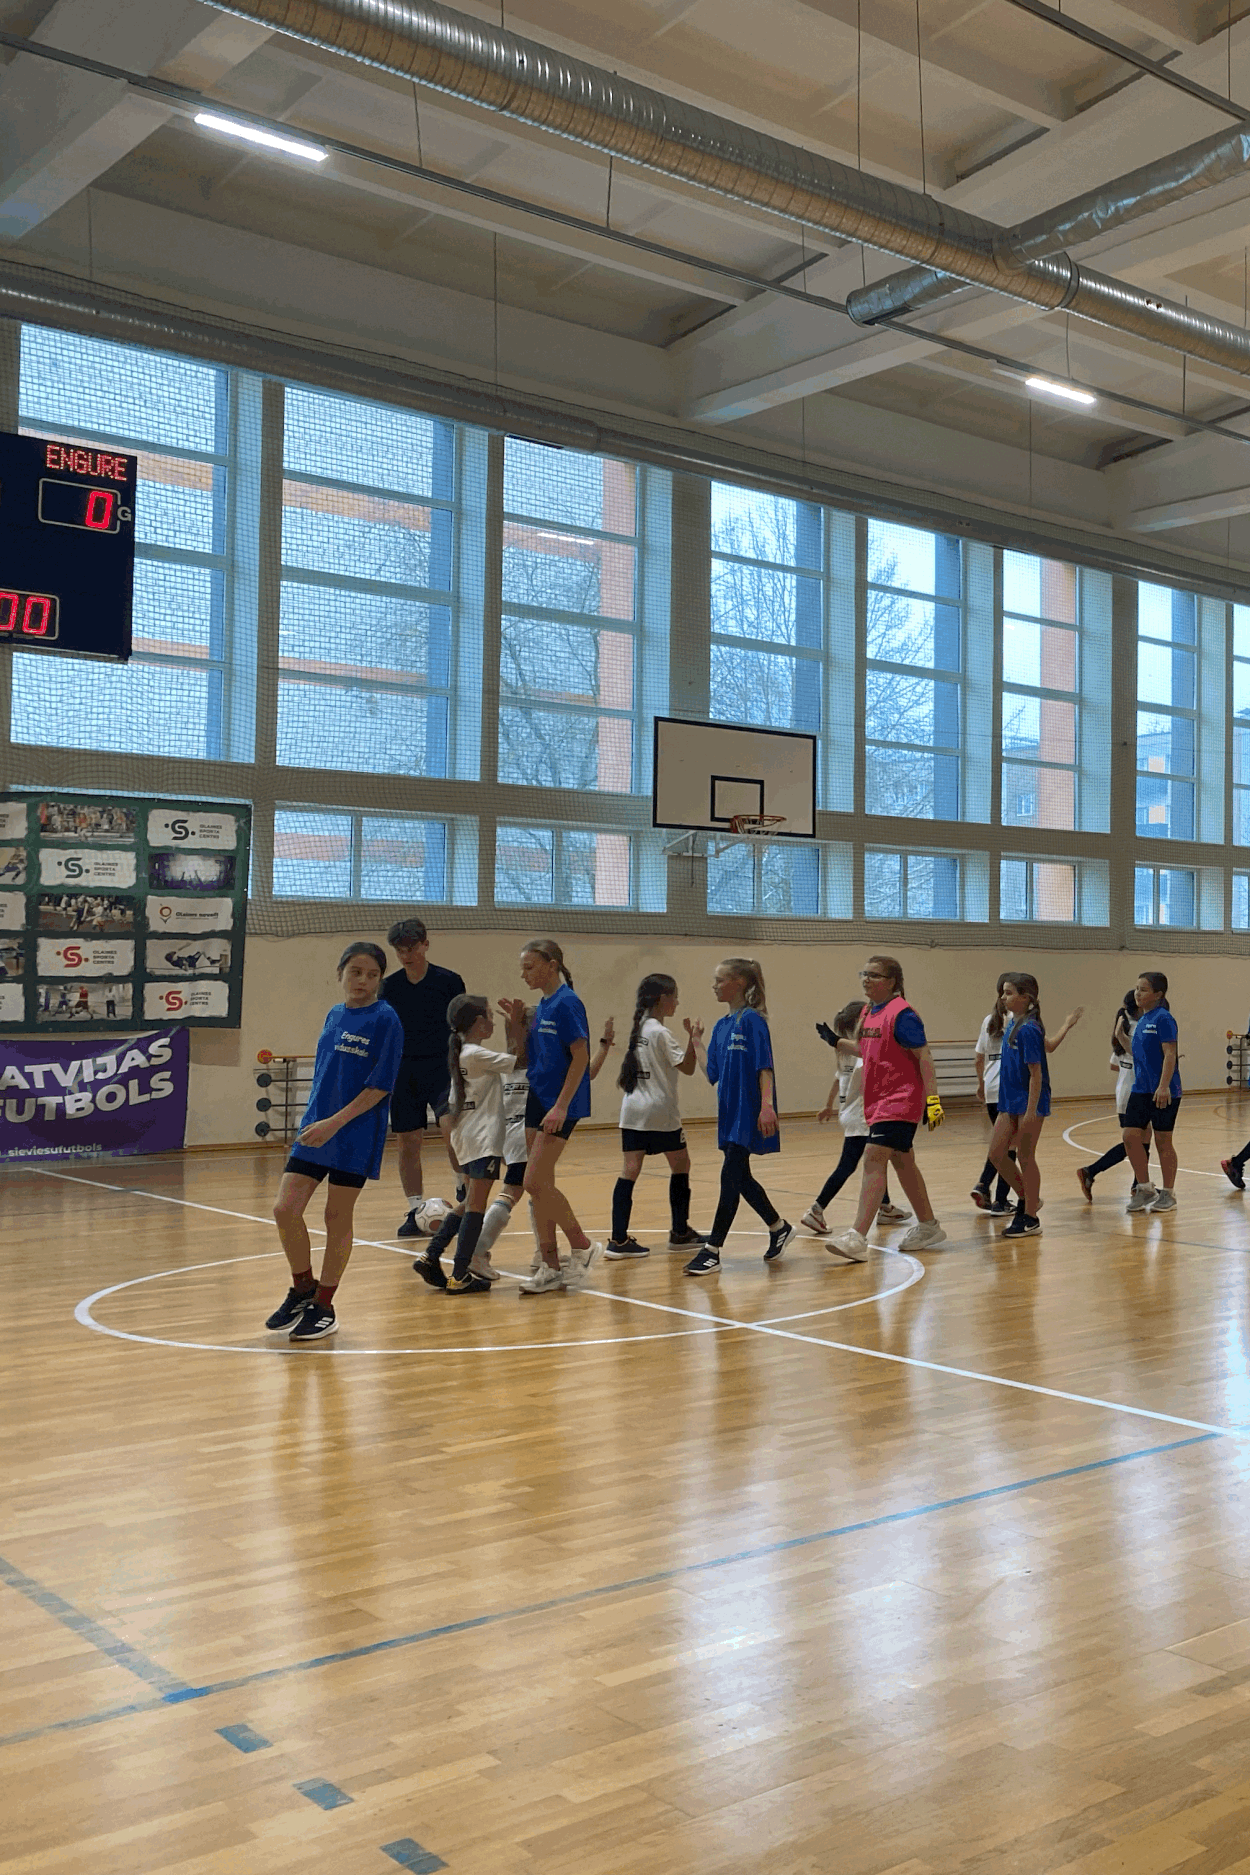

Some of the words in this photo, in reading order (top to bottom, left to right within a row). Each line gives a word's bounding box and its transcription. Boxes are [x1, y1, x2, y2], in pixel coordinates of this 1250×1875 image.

[46, 444, 127, 481] ENGURE
[85, 490, 113, 529] 0
[117, 507, 131, 521] G
